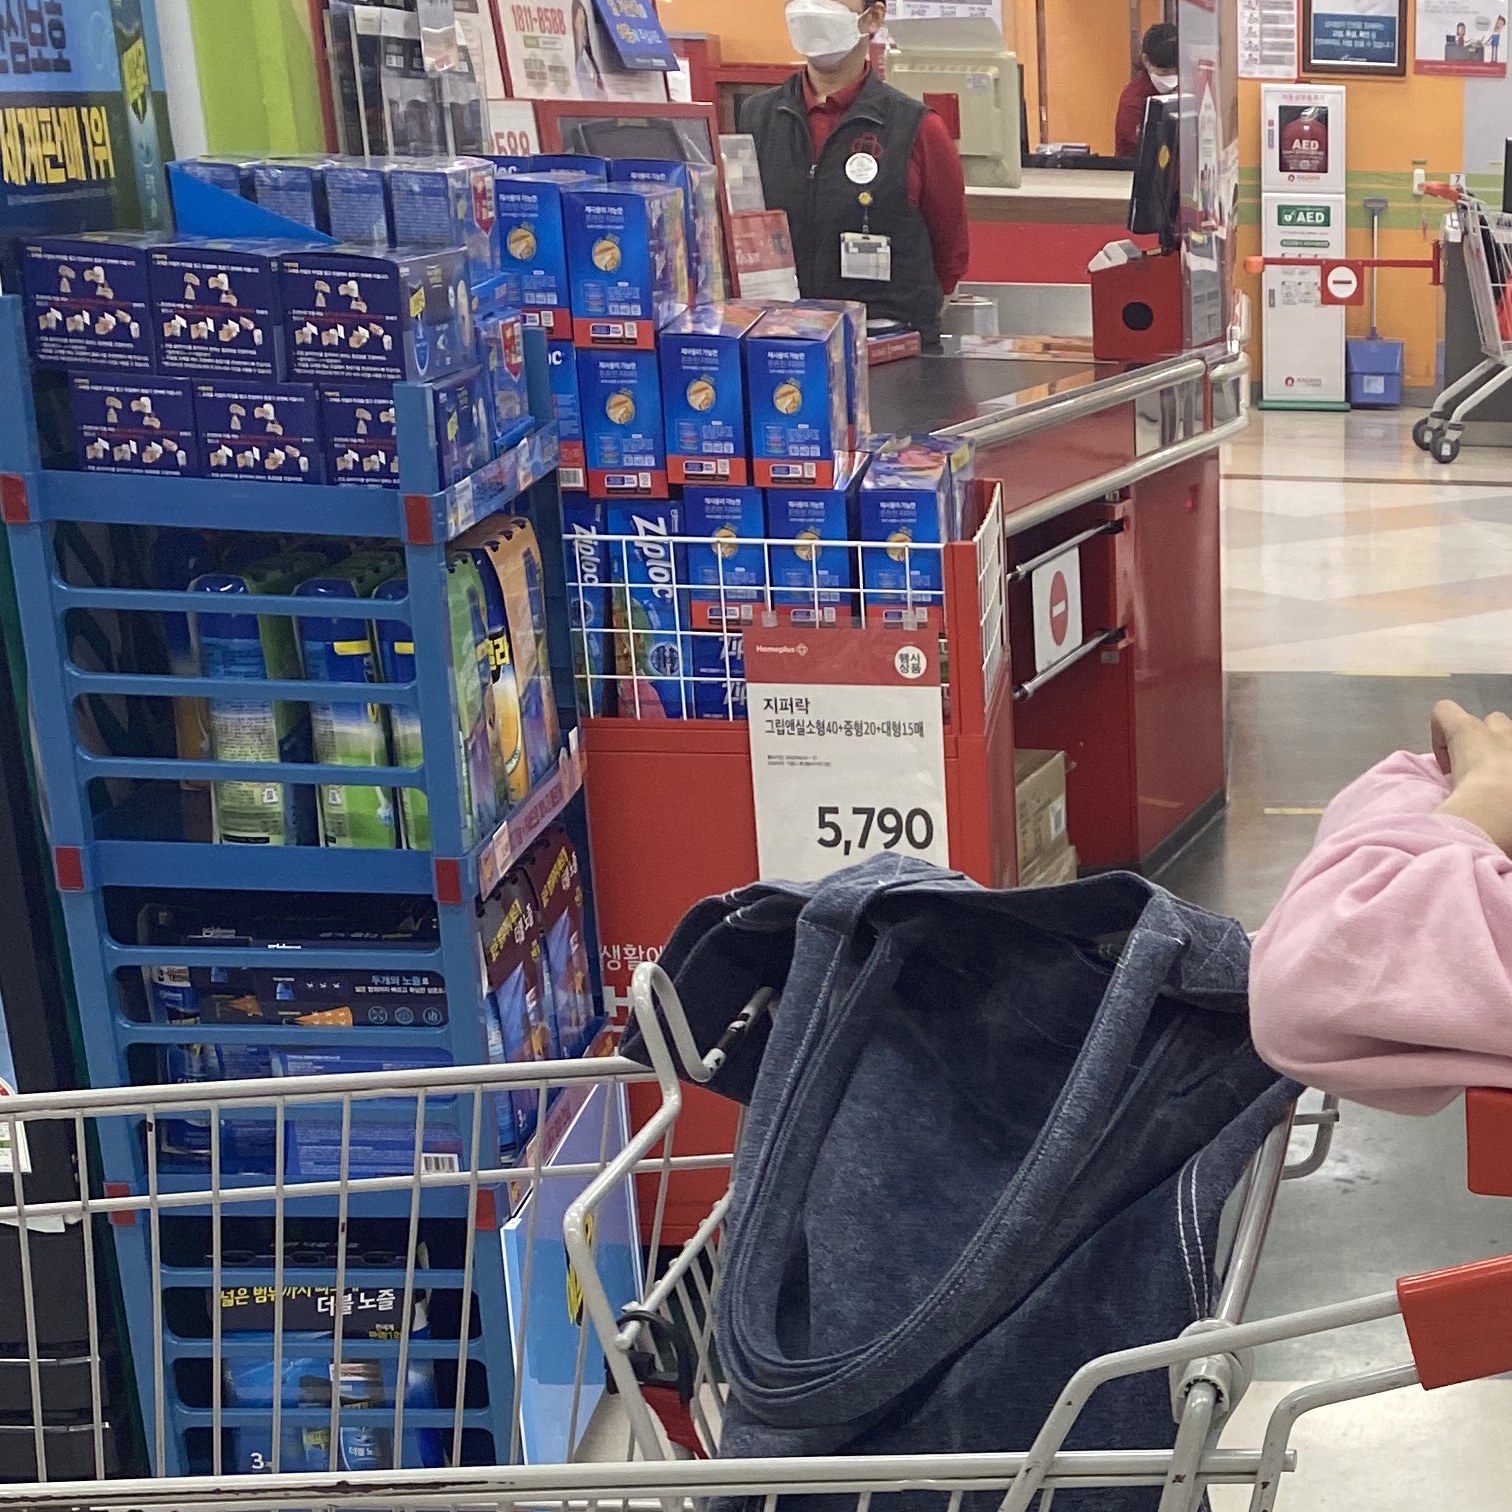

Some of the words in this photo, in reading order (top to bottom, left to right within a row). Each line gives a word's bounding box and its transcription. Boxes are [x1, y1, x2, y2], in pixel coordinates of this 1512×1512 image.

[512, 4, 567, 35] 1811-8588
[1292, 139, 1319, 150] AED
[1296, 211, 1325, 223] AED
[764, 697, 810, 715] 지퍼락
[817, 805, 934, 856] 5,790
[371, 974, 400, 986] 두개의
[317, 1294, 355, 1317] 더블
[357, 1289, 396, 1311] 노즐
[250, 1452, 264, 1470] 3
